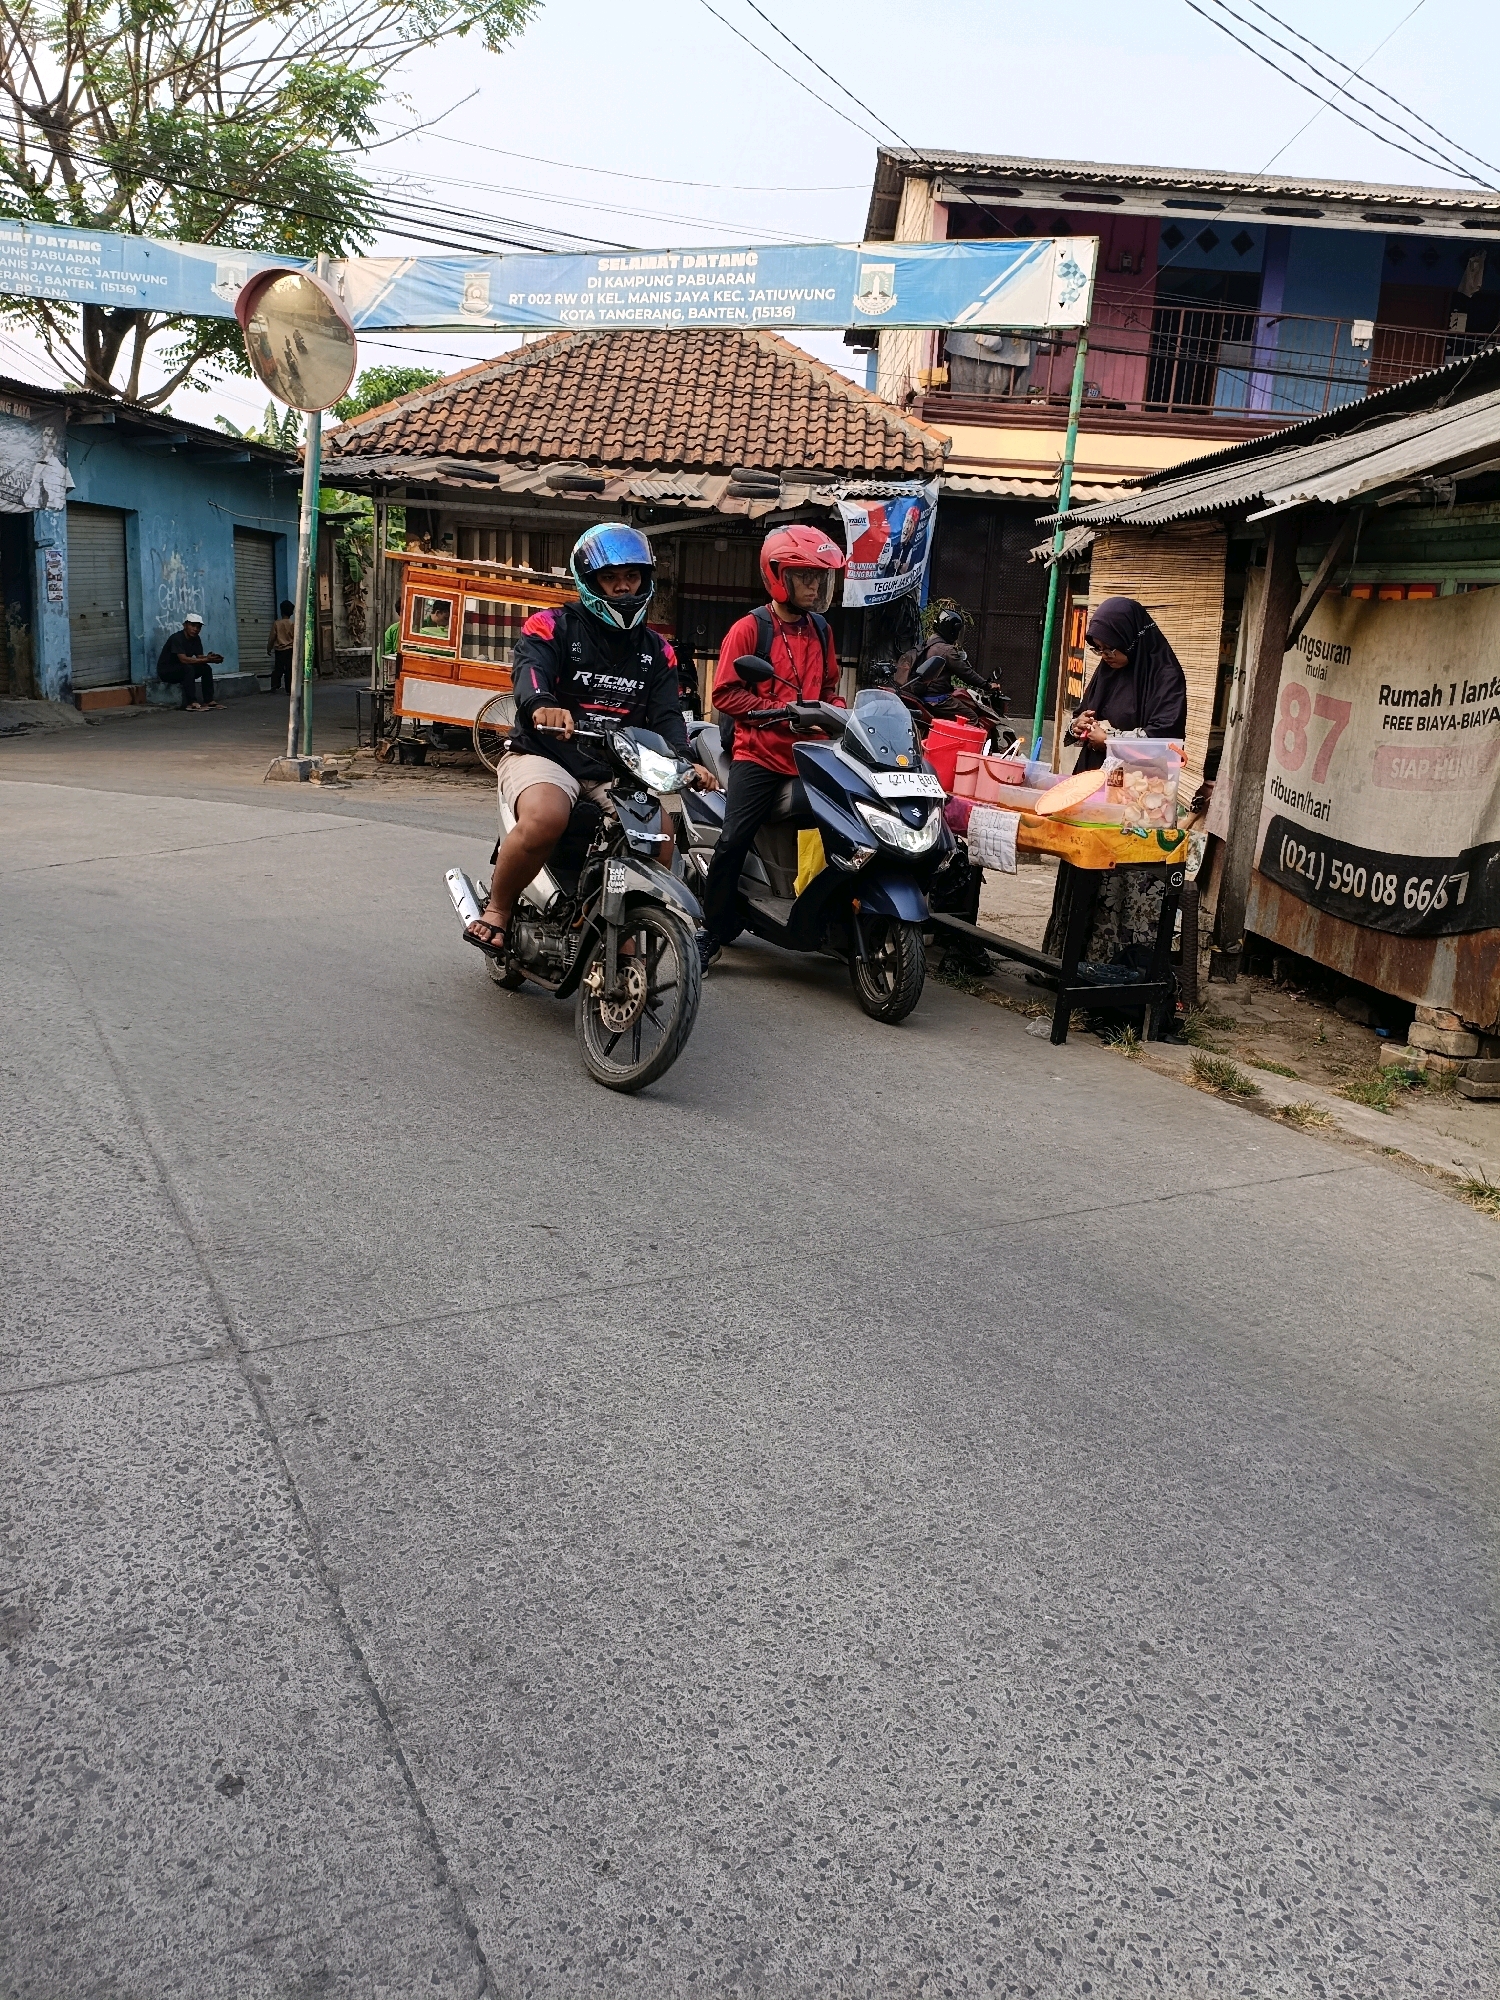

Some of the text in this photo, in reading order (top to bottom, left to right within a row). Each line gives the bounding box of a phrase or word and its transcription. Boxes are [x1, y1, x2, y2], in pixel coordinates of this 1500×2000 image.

[36, 234, 102, 252] DATANG
[0, 246, 101, 266] UNG PABUARAN
[598, 252, 759, 272] SELAMAT DATANG
[31, 262, 63, 274] JAYA
[66, 266, 93, 278] KEC.
[95, 269, 168, 286] JATIUWUNG
[587, 272, 756, 289] DI KAMPUNG PABUARAN
[35, 285, 70, 299] TANA
[44, 275, 98, 291] BANTEN.
[100, 281, 137, 296] (15136)
[508, 288, 836, 305] RT 002 RW 01 KEL. MANIS JAYA KEC. JATIUWUNG
[559, 305, 796, 321] KOTA TANGERANG, BANTEN. (15136)
[13, 403, 32, 419] RAYA
[572, 670, 646, 690] RACING
[1305, 662, 1329, 682] mulai
[1379, 683, 1443, 708] Rumah
[1448, 682, 1458, 706] 1
[1382, 714, 1414, 731] FREE
[1274, 681, 1353, 785] 87
[1390, 757, 1431, 779] SIAP
[1270, 775, 1332, 822] ribuan/hari
[1279, 834, 1325, 890] (021)
[1329, 858, 1367, 898] 590
[1370, 871, 1398, 906] 08
